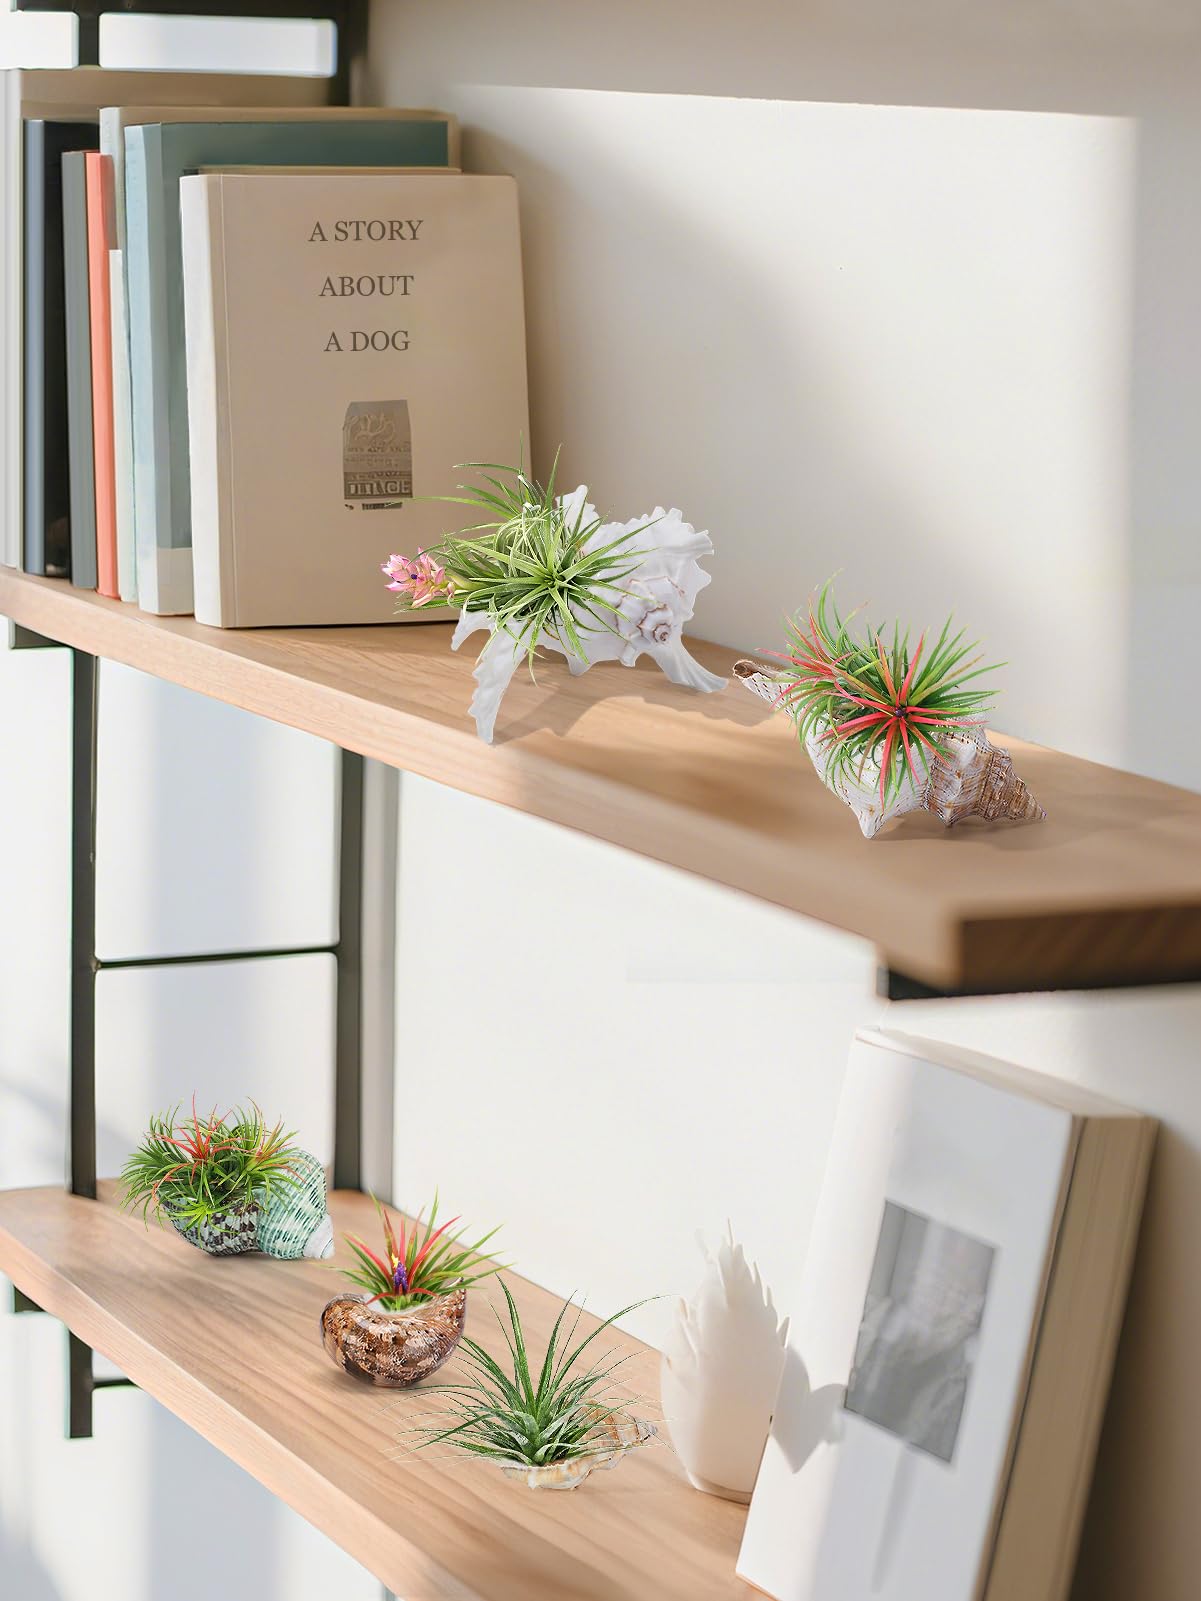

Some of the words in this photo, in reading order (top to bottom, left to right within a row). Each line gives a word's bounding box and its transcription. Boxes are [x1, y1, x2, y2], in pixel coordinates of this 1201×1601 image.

[308, 221, 328, 242] A
[334, 219, 424, 242] STORY
[318, 275, 415, 297] ABOUT
[323, 330, 344, 352] A
[349, 330, 411, 352] DOG
